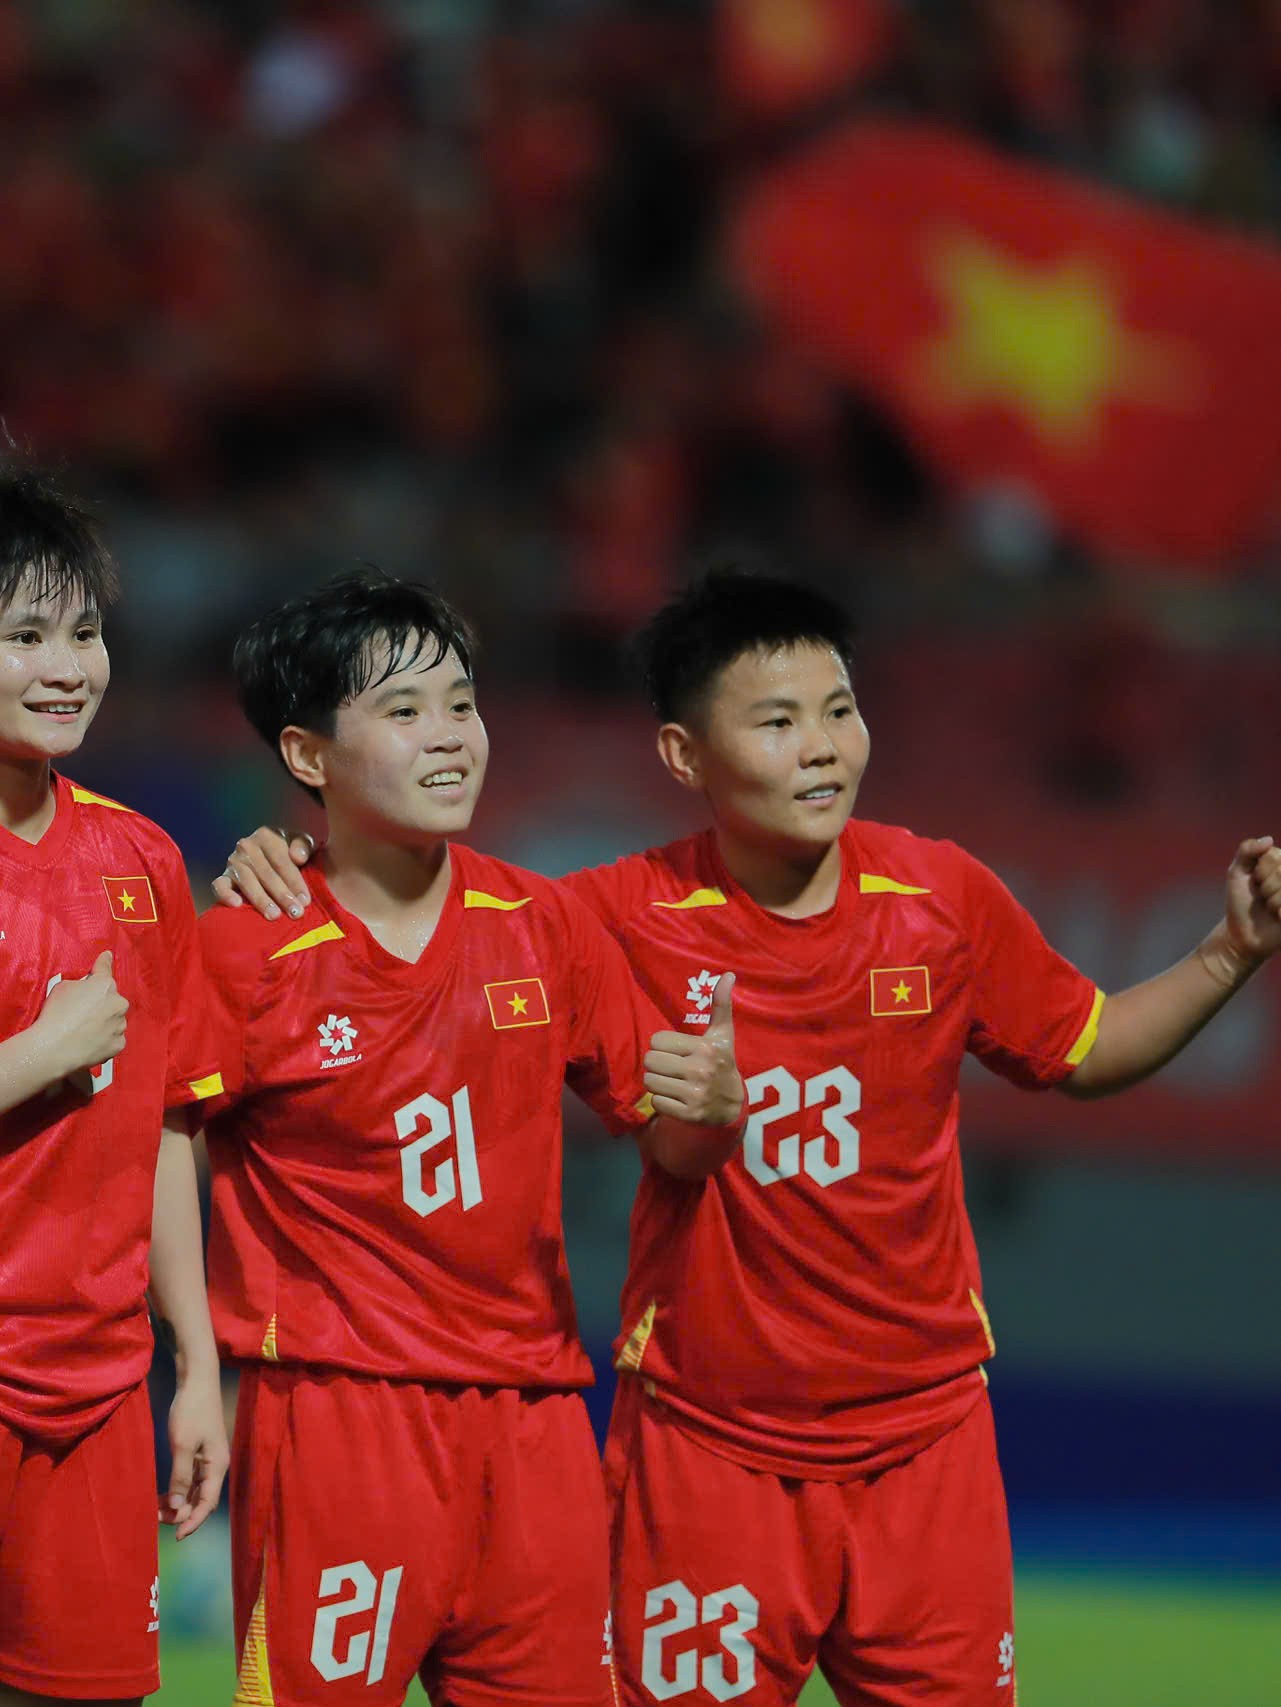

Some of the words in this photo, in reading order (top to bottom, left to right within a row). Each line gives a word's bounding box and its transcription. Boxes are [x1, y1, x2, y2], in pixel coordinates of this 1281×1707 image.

[320, 1053, 362, 1070] JOGARBOLA
[394, 1085, 484, 1219] 21
[743, 1065, 862, 1188] 23
[310, 1560, 405, 1687] 21
[641, 1579, 760, 1703] 23
